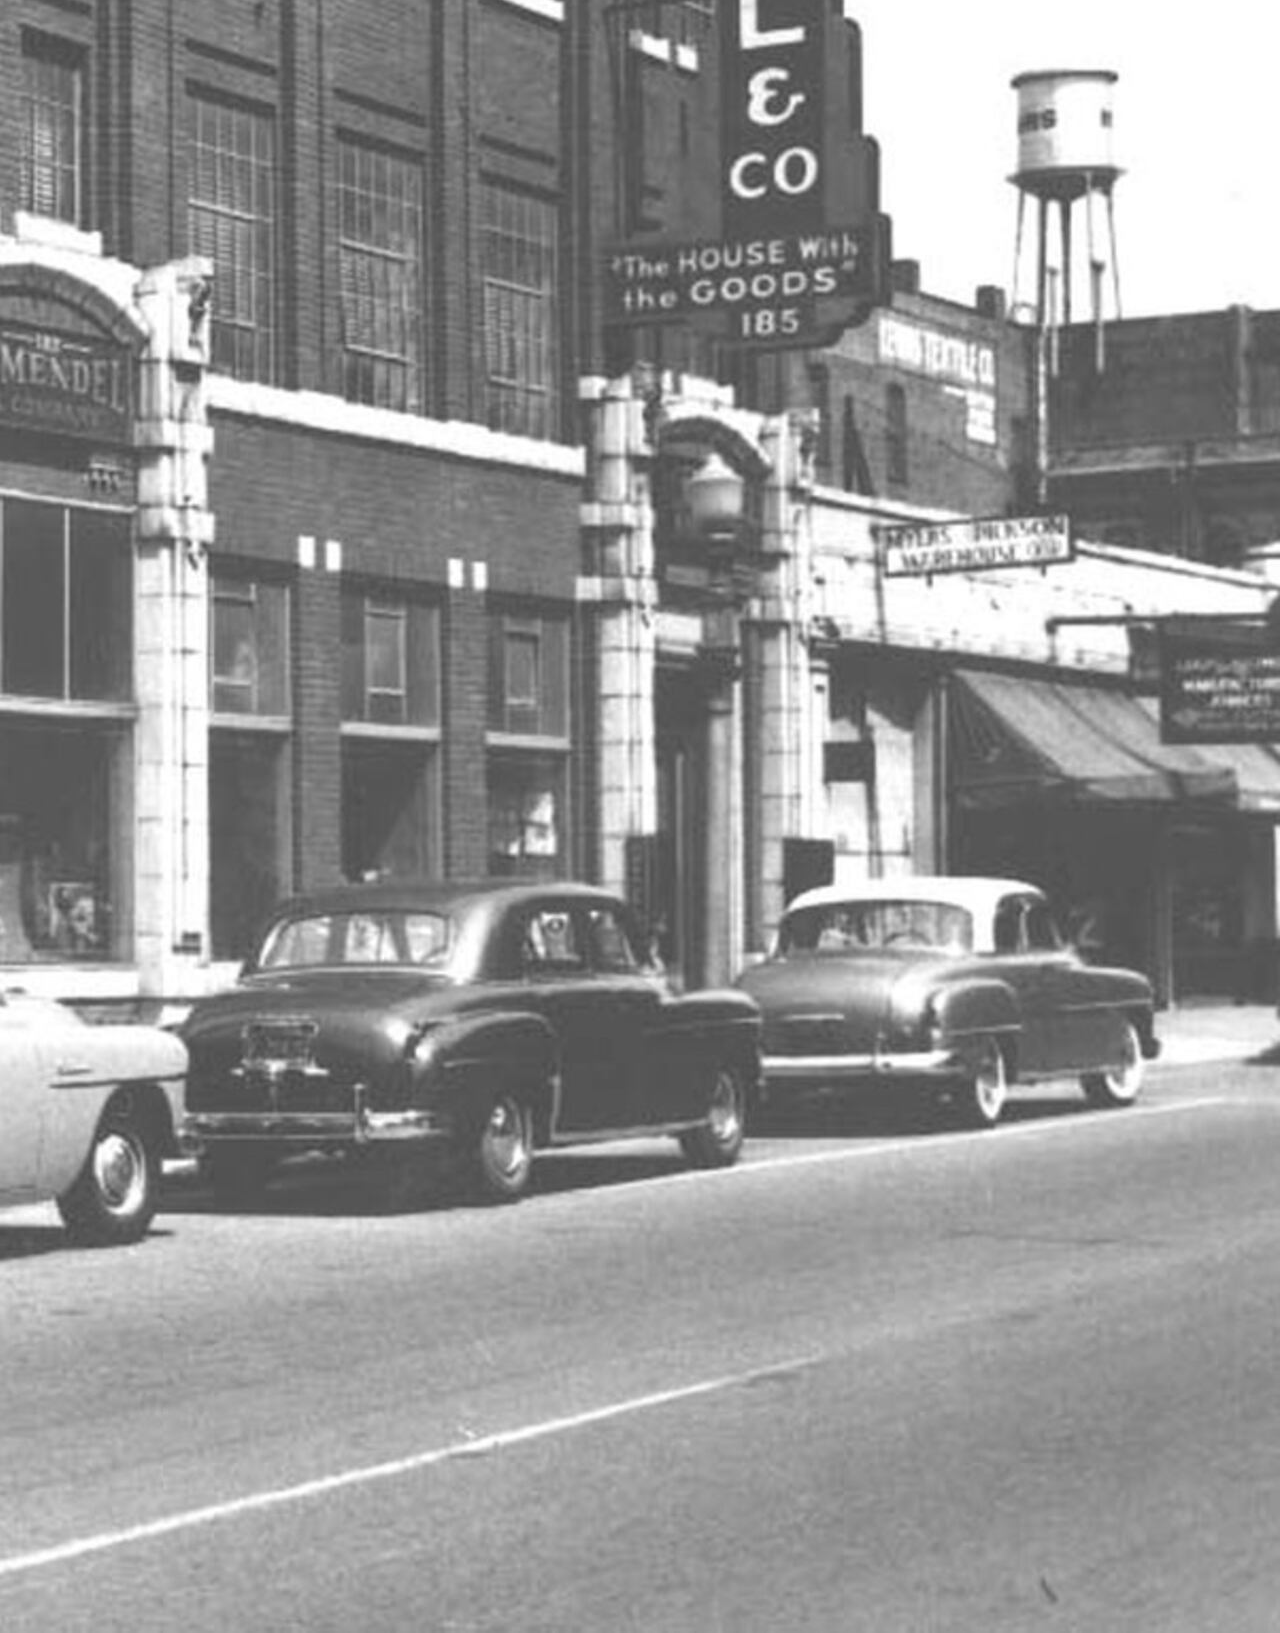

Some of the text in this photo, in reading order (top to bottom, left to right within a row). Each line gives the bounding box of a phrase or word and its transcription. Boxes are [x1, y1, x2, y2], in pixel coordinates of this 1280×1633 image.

[747, 67, 805, 126] &
[730, 146, 817, 200] CO
[679, 240, 786, 273] HOUSE
[799, 233, 858, 259] With
[623, 286, 678, 310] the
[742, 308, 799, 337] 185
